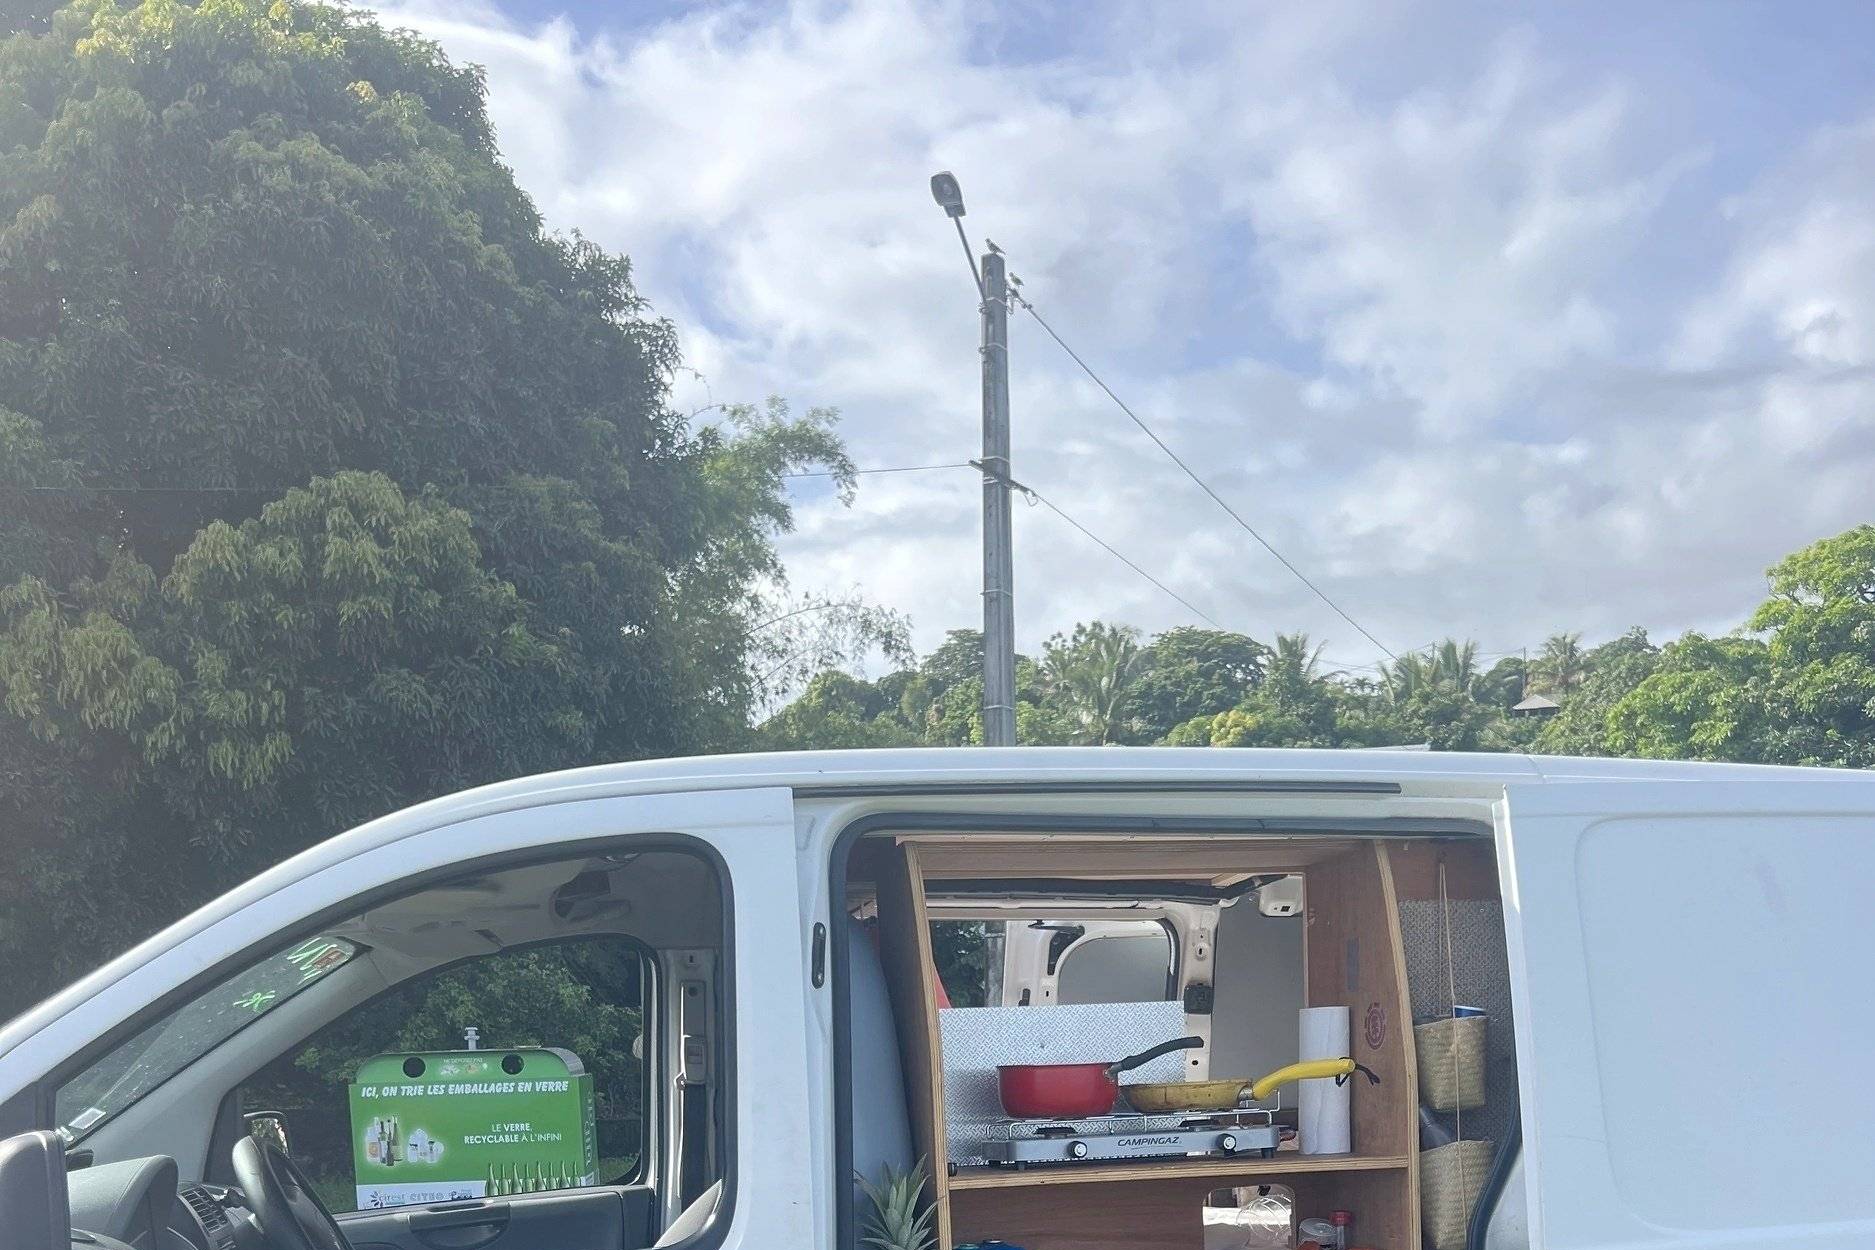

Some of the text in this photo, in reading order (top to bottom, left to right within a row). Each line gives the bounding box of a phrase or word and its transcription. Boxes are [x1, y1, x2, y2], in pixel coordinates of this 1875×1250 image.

[361, 1080, 569, 1100] ICI, ON TRIE LES EMBALLAGES EN VERRE
[492, 1124, 502, 1132] LE
[464, 1133, 562, 1144] RECYCLABLE À L'INFINI
[1117, 1136, 1180, 1147] CAMPINGAZ
